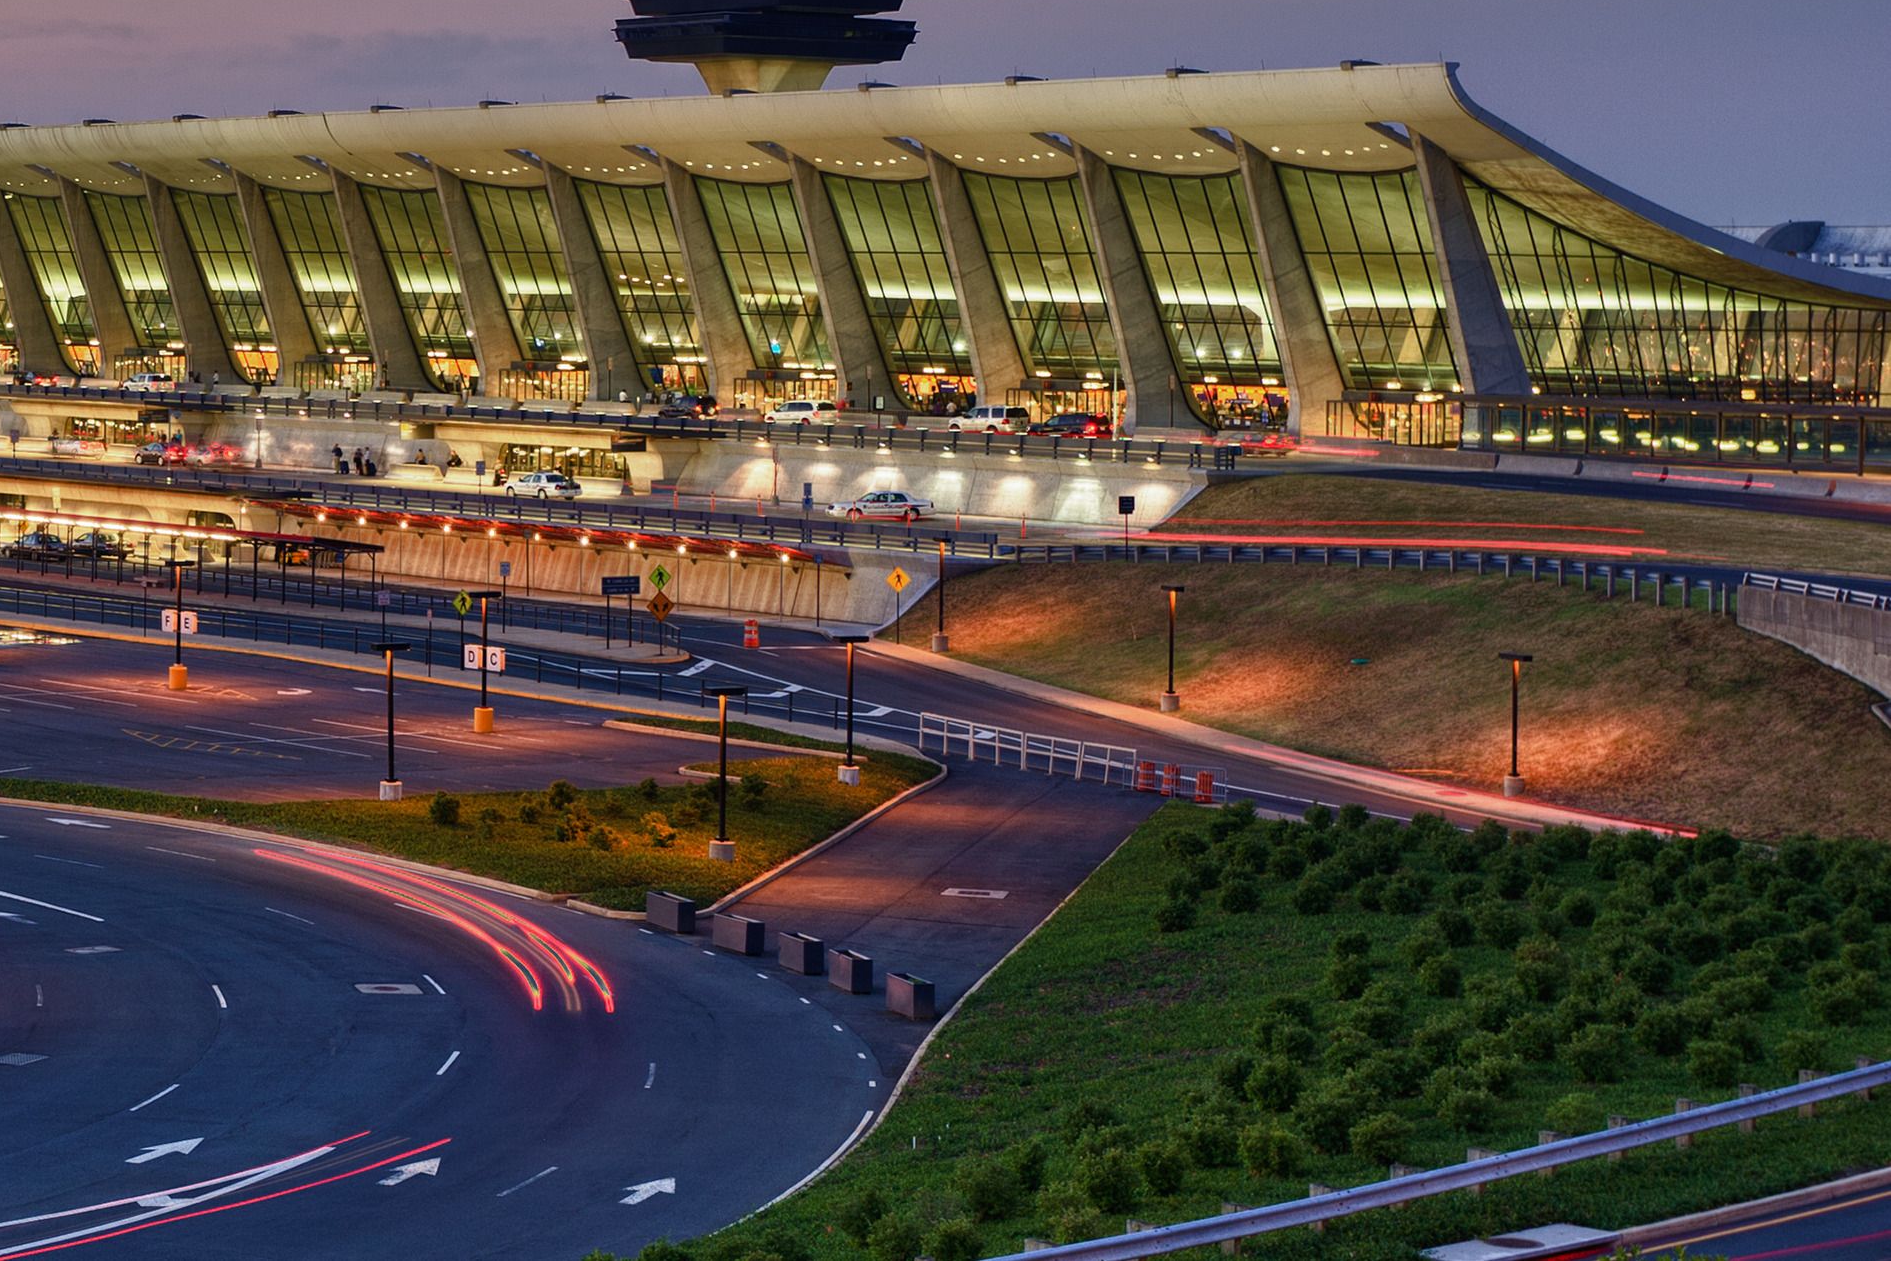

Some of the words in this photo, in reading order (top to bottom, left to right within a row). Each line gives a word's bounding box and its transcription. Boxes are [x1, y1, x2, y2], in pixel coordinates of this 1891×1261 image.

[165, 615, 171, 627] F
[184, 617, 190, 629] E
[468, 650, 475, 663] D
[490, 652, 498, 666] C
